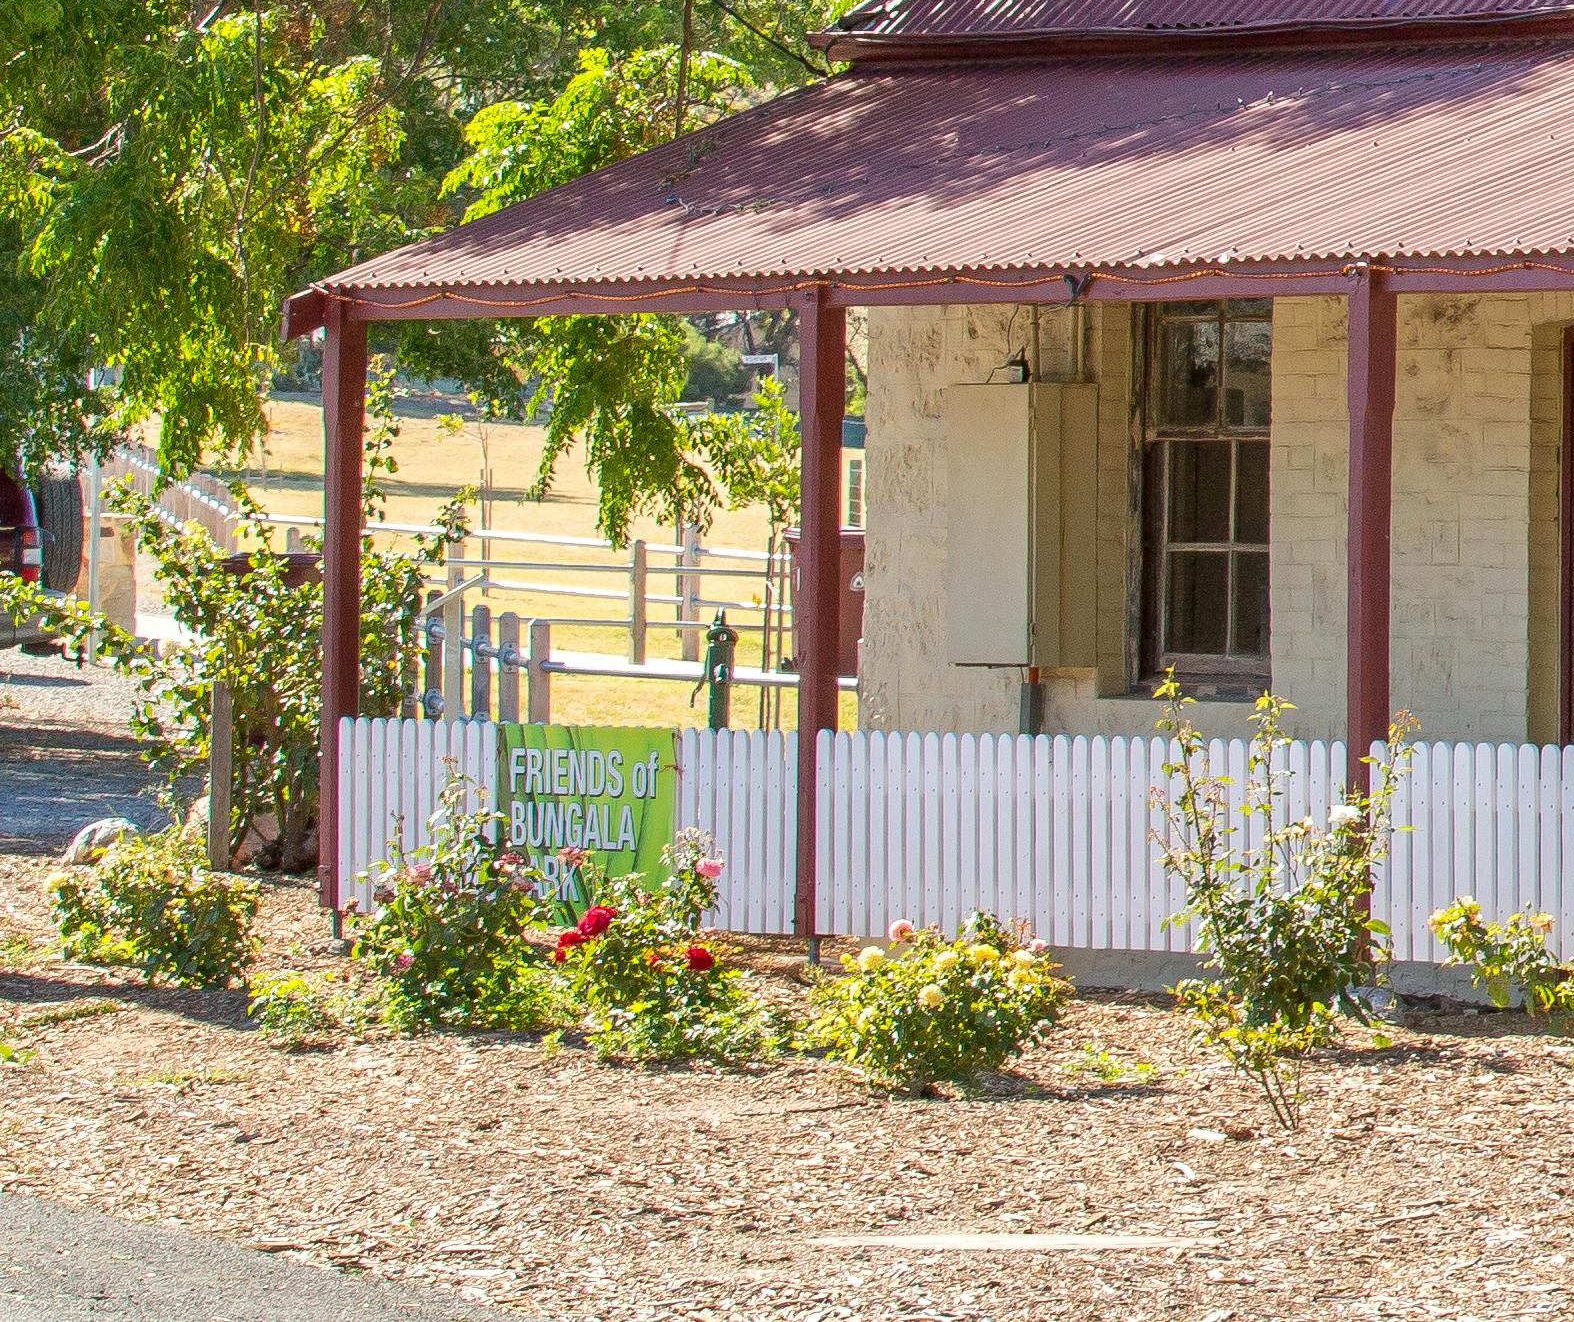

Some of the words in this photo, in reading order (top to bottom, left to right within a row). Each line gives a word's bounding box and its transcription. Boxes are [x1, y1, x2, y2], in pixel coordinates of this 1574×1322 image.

[510, 747, 623, 797] FRIENDS
[632, 750, 660, 799] of
[510, 800, 636, 851] BUNGALA
